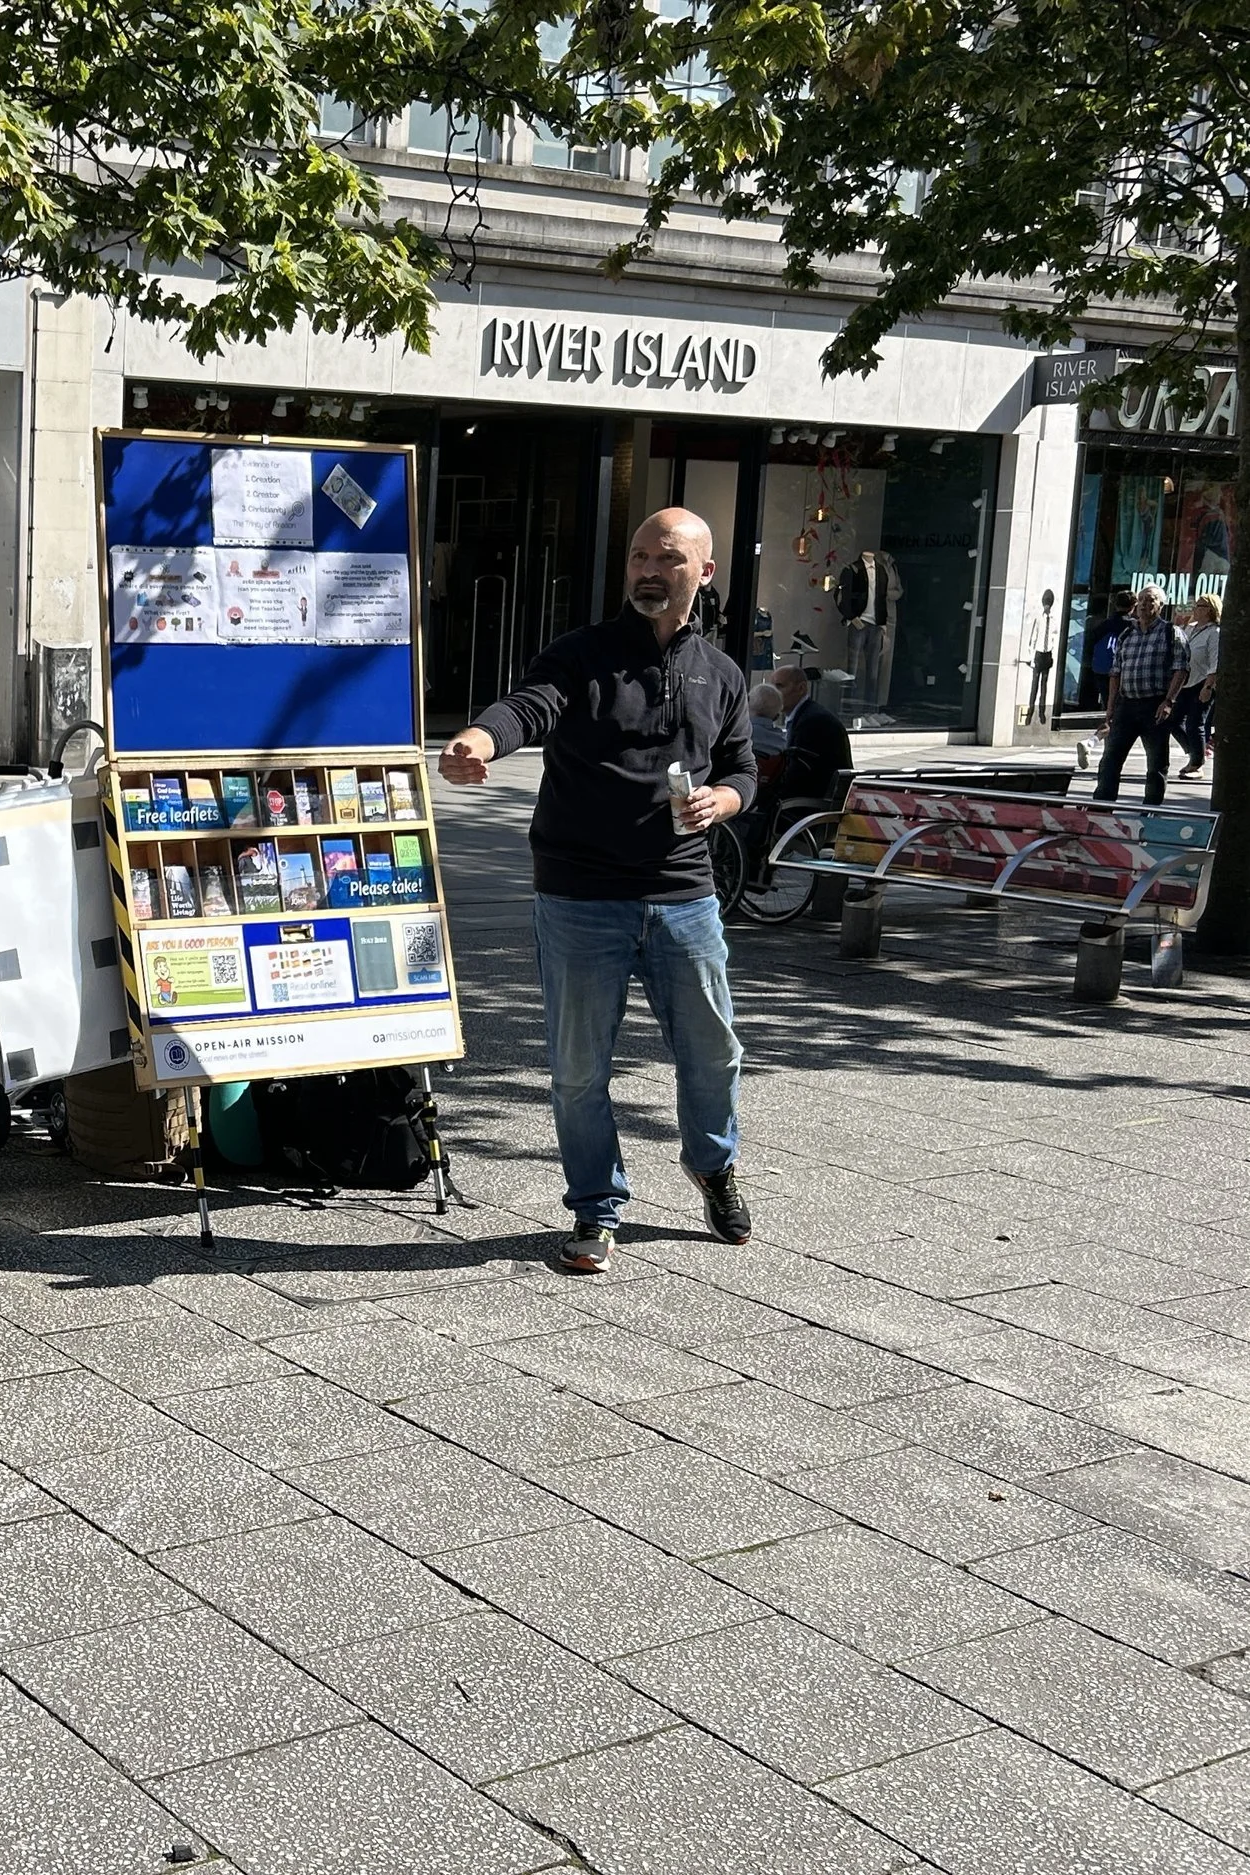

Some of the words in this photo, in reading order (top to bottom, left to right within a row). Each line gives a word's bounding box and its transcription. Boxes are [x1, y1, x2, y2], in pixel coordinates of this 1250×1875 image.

[485, 317, 607, 383] RIVER
[616, 329, 762, 394] ISLAND
[1053, 359, 1096, 377] RIVER
[1045, 378, 1100, 397] ISLAN
[251, 475, 280, 483] Creation
[253, 490, 280, 498] Creator
[248, 504, 287, 515] Christianity
[138, 808, 167, 824] Free
[170, 807, 219, 824] leaflets
[350, 880, 390, 896] Please
[392, 877, 423, 893] take!
[173, 909, 196, 917] Living?
[146, 941, 159, 951] ARE
[162, 940, 176, 950] YOU
[184, 938, 205, 949] GOOD
[207, 937, 239, 947] PERSON?
[310, 980, 337, 989] online!
[372, 1026, 446, 1043] oamission.com
[195, 1038, 251, 1052] OPEN-AIR
[257, 1034, 304, 1047] MISSION
[197, 1054, 212, 1063] Good
[238, 1051, 247, 1059] the
